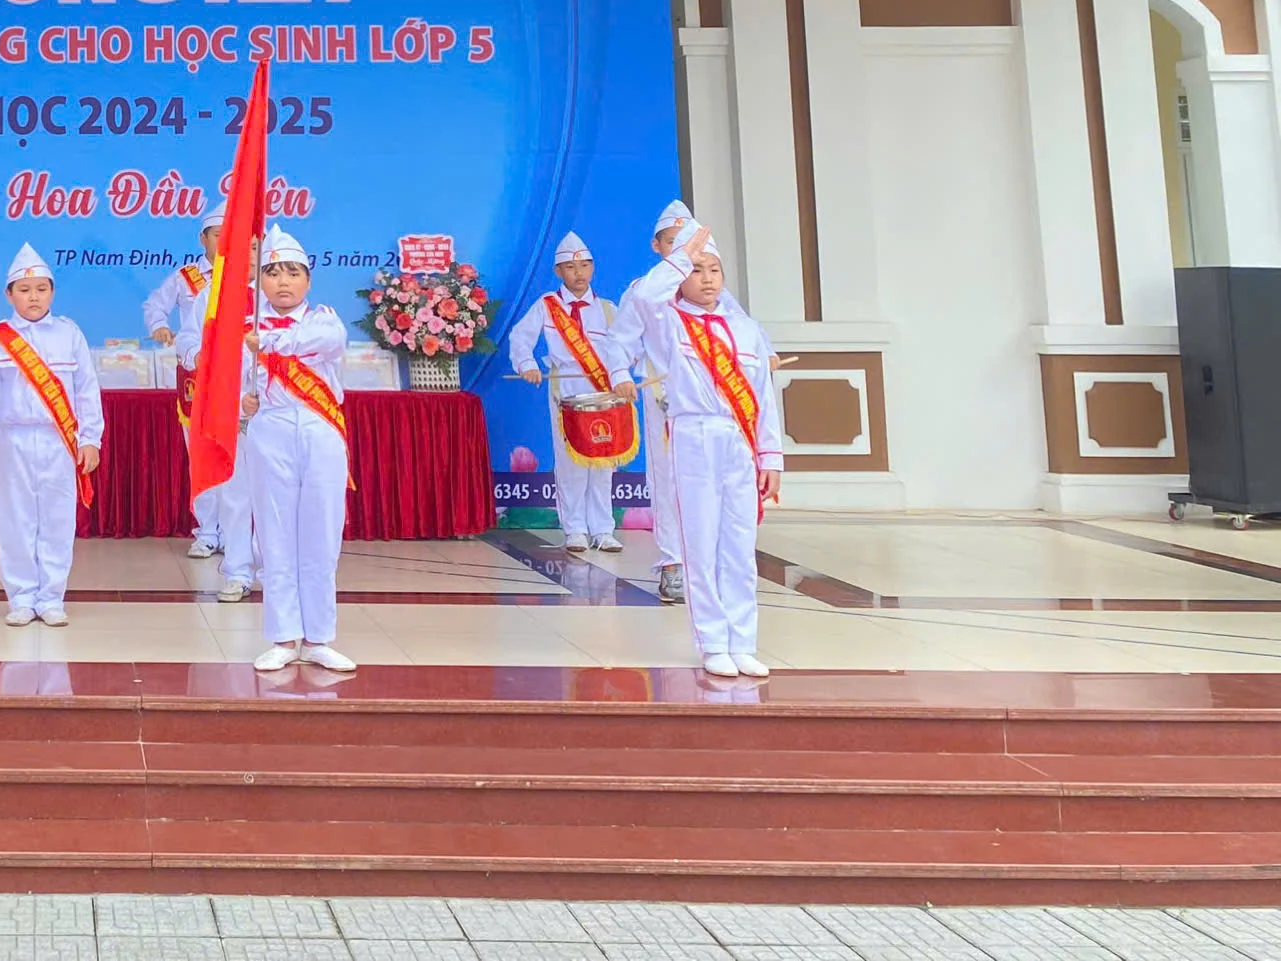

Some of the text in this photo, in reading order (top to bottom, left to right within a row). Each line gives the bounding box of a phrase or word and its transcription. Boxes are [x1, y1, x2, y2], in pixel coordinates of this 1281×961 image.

[39, 25, 131, 63] CHO
[143, 25, 237, 73] HỌC
[248, 24, 356, 63] SINH
[370, 17, 456, 63] LỚP
[467, 25, 495, 63] 5
[78, 96, 188, 135] 2024
[7, 171, 97, 219] Hoa
[107, 170, 206, 218] Đầu
[55, 250, 77, 266] TP
[81, 250, 124, 266] Nam
[129, 249, 177, 269] Định,
[321, 251, 333, 267] 5
[337, 250, 379, 267] năm
[494, 484, 530, 499] 6345
